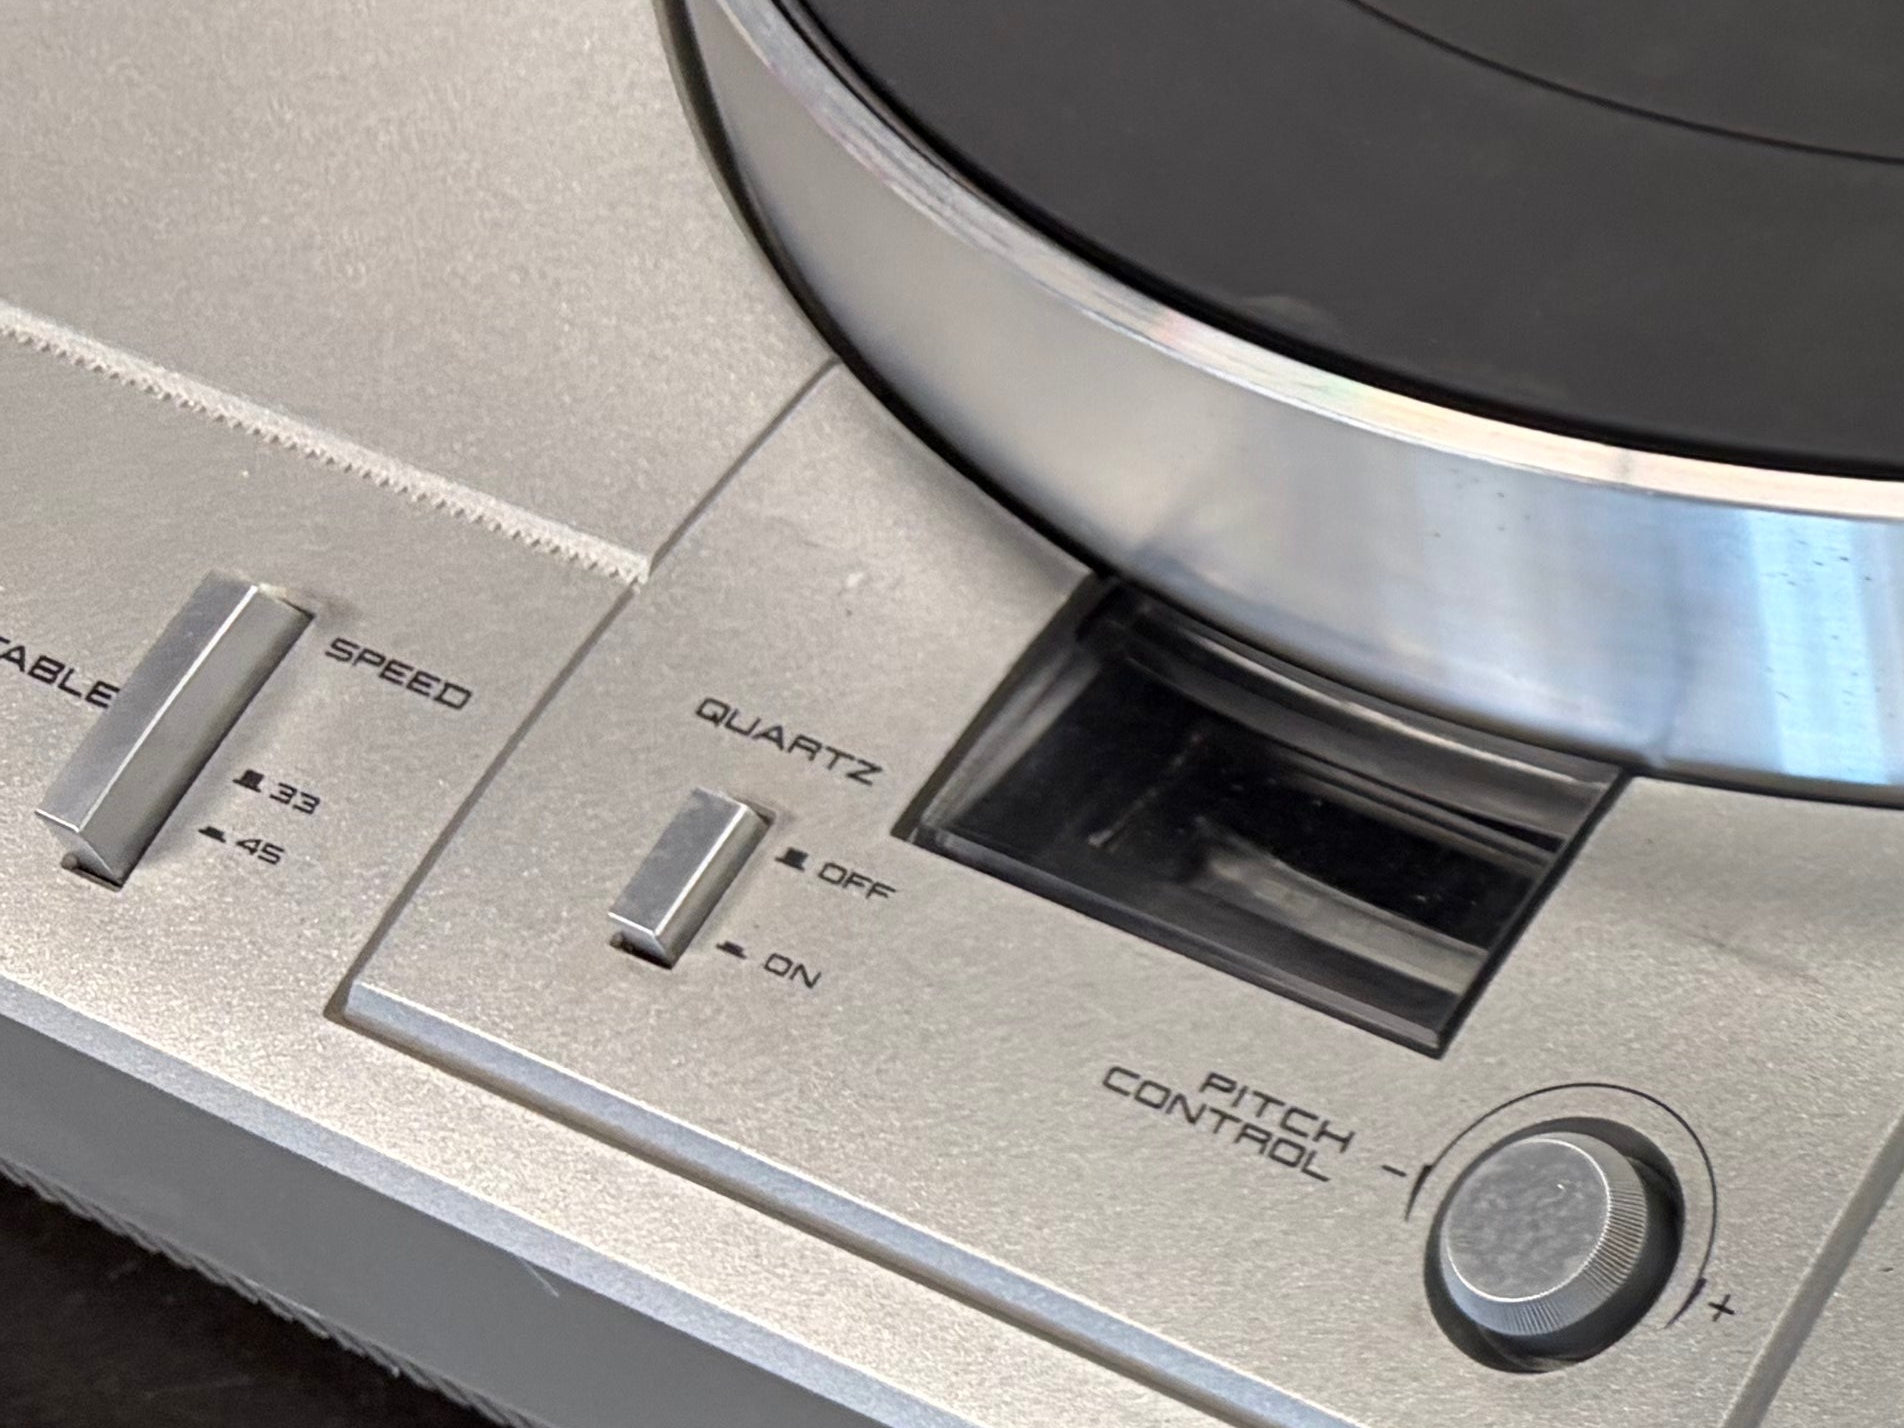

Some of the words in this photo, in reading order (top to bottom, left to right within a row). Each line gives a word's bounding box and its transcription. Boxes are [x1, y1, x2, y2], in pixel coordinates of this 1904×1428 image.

[0, 636, 120, 709] ABLE
[325, 637, 473, 711] SPEED
[695, 696, 884, 787] QUARTZ
[270, 780, 322, 815] 33
[235, 836, 286, 865] 45
[817, 861, 897, 900] OFF
[763, 952, 823, 989] ON
[1101, 1065, 1332, 1183] CONTROL
[1198, 1071, 1357, 1154] PITCH
